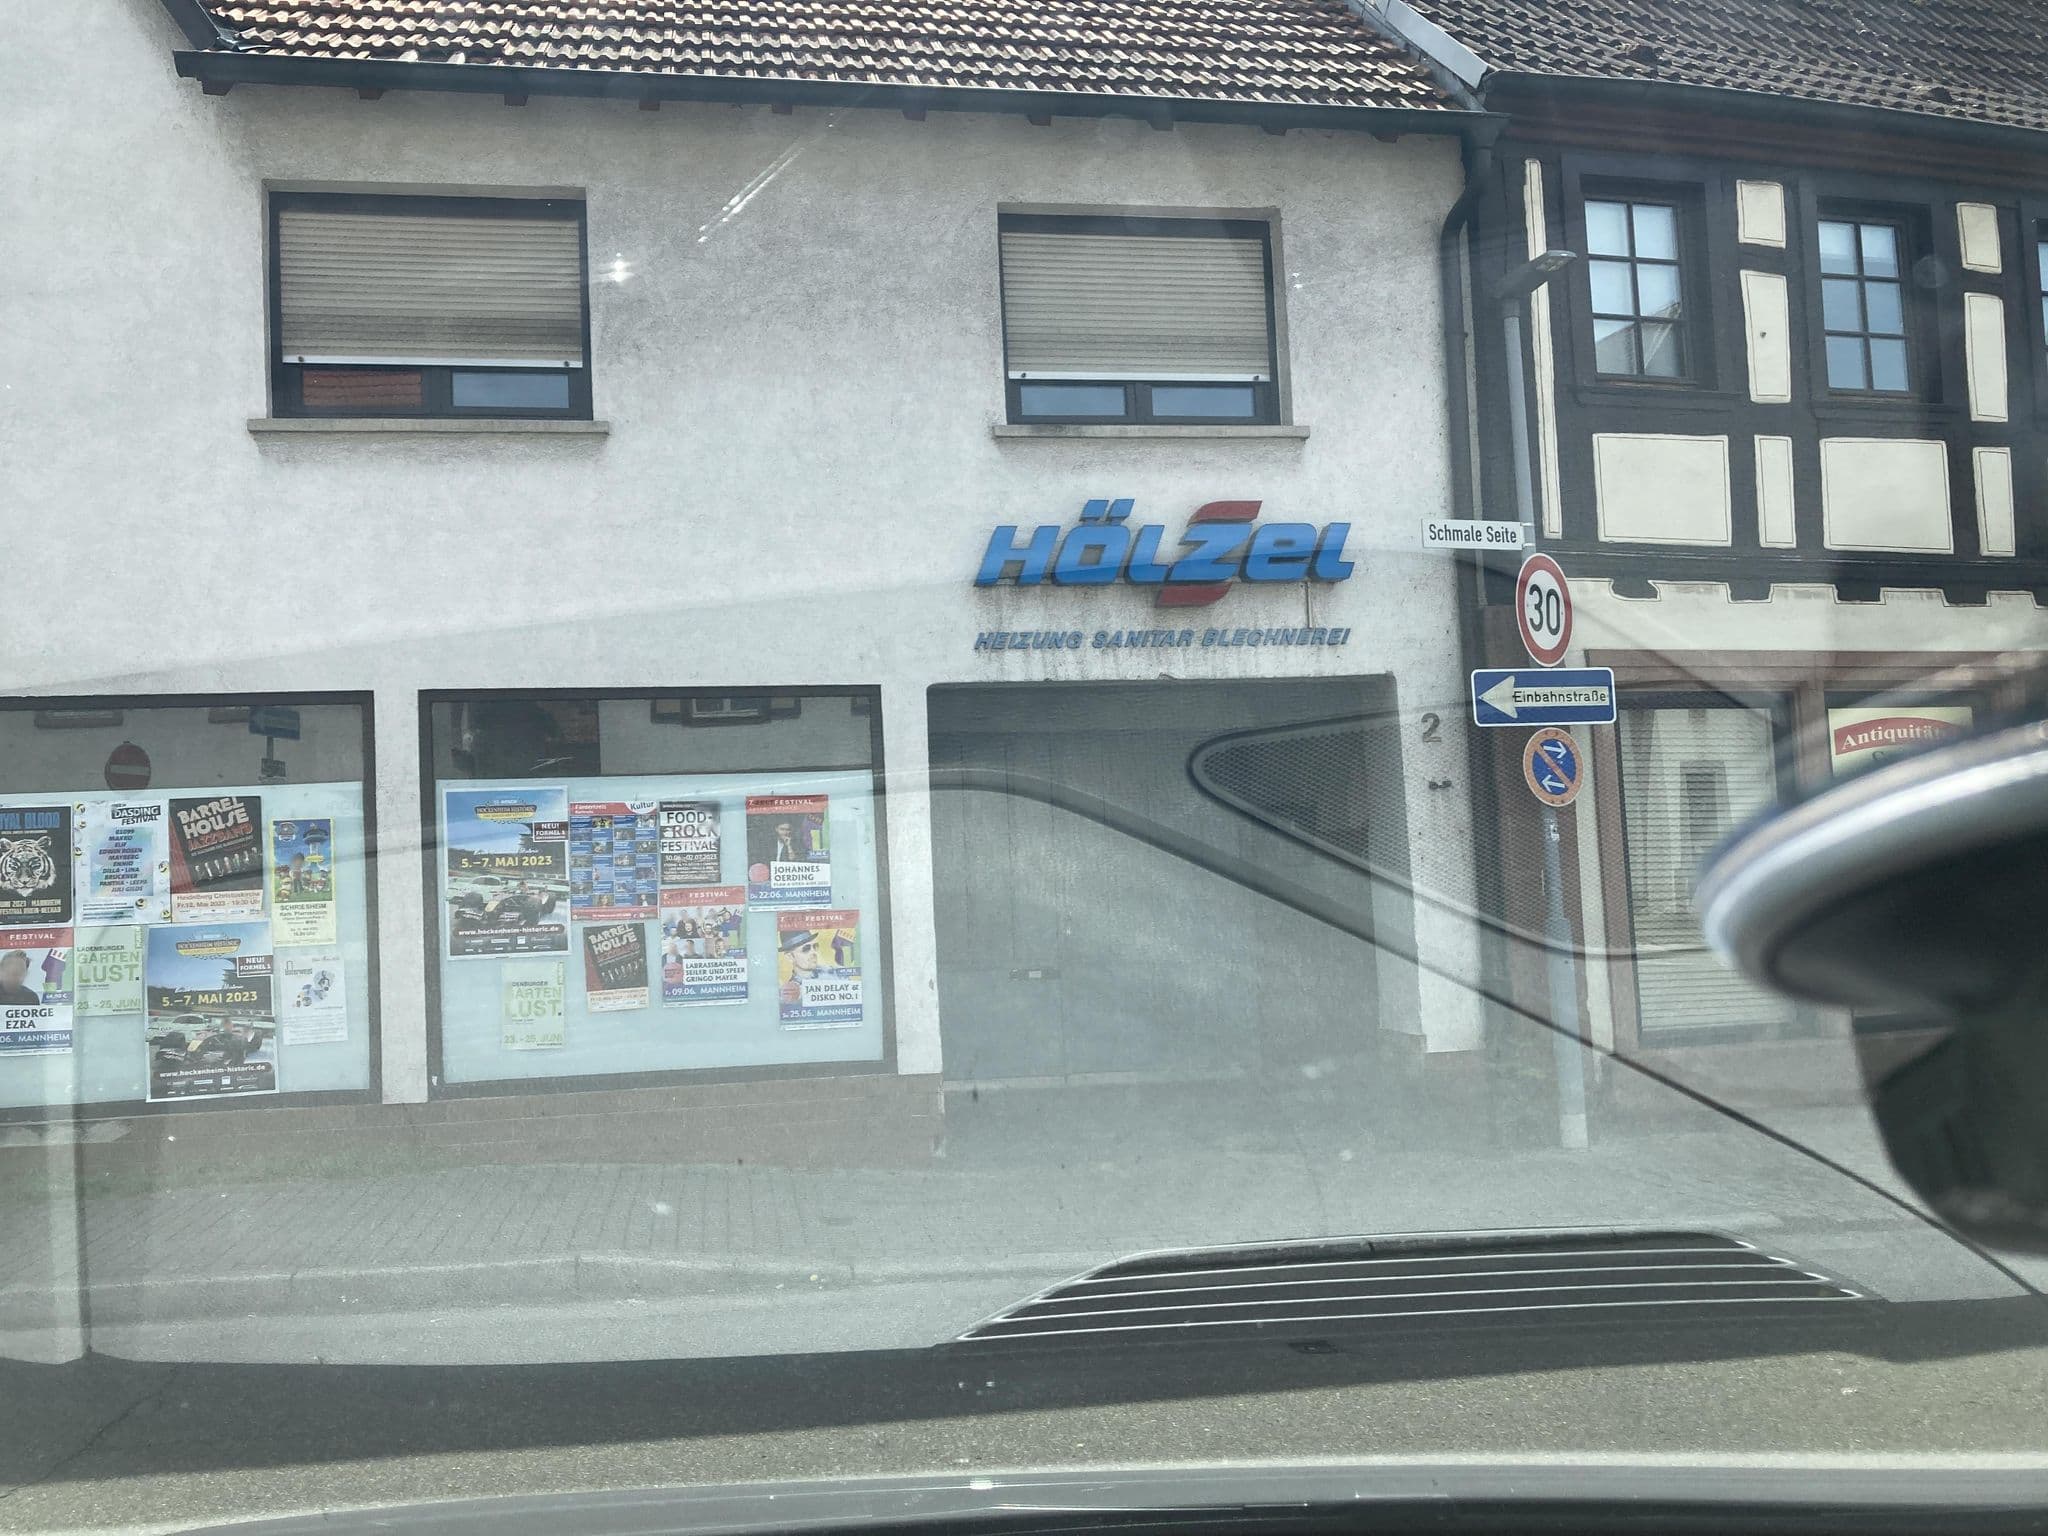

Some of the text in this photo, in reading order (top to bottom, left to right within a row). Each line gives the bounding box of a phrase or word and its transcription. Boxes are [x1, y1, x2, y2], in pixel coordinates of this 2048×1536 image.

[1429, 525, 1517, 543] Schmale Seite
[1528, 583, 1561, 636] 30
[974, 630, 1083, 650] HEIZUNG
[1201, 627, 1351, 647] BLECHNEREI
[1512, 689, 1607, 704] Einbahnstraße
[1420, 712, 1442, 744] 2
[114, 806, 159, 818] DASDING
[177, 796, 245, 824] BARREL
[630, 801, 654, 811] Kultur
[121, 815, 159, 825] FESTIVAL
[182, 807, 250, 839] HOUSE
[661, 840, 718, 852] FESTIVAL
[495, 856, 519, 868] MAI
[522, 855, 553, 866] 2023
[774, 865, 821, 874] JOHANNES
[774, 874, 814, 882] OERDING
[785, 890, 830, 898] MANNHEIM
[805, 914, 843, 922] FESTIVAL
[588, 923, 634, 944] BARREL
[592, 931, 638, 955] HOUSE
[77, 951, 140, 964] GARTEN
[245, 956, 265, 964] NEU!
[686, 975, 714, 983] GRINGO
[700, 985, 746, 994] MANNHEIM
[805, 985, 821, 994] JAN
[824, 984, 850, 992] DELAY
[198, 993, 223, 1005] MAI
[226, 991, 258, 1003] 2023
[810, 993, 837, 1002] DISKO
[5, 1007, 54, 1019] GEORGE
[816, 1007, 861, 1016] MANNHEIM
[5, 1019, 36, 1030] EZRA
[18, 1033, 71, 1042] MANNHEIM
[159, 1064, 267, 1078] www.hockenheim-historic.de
